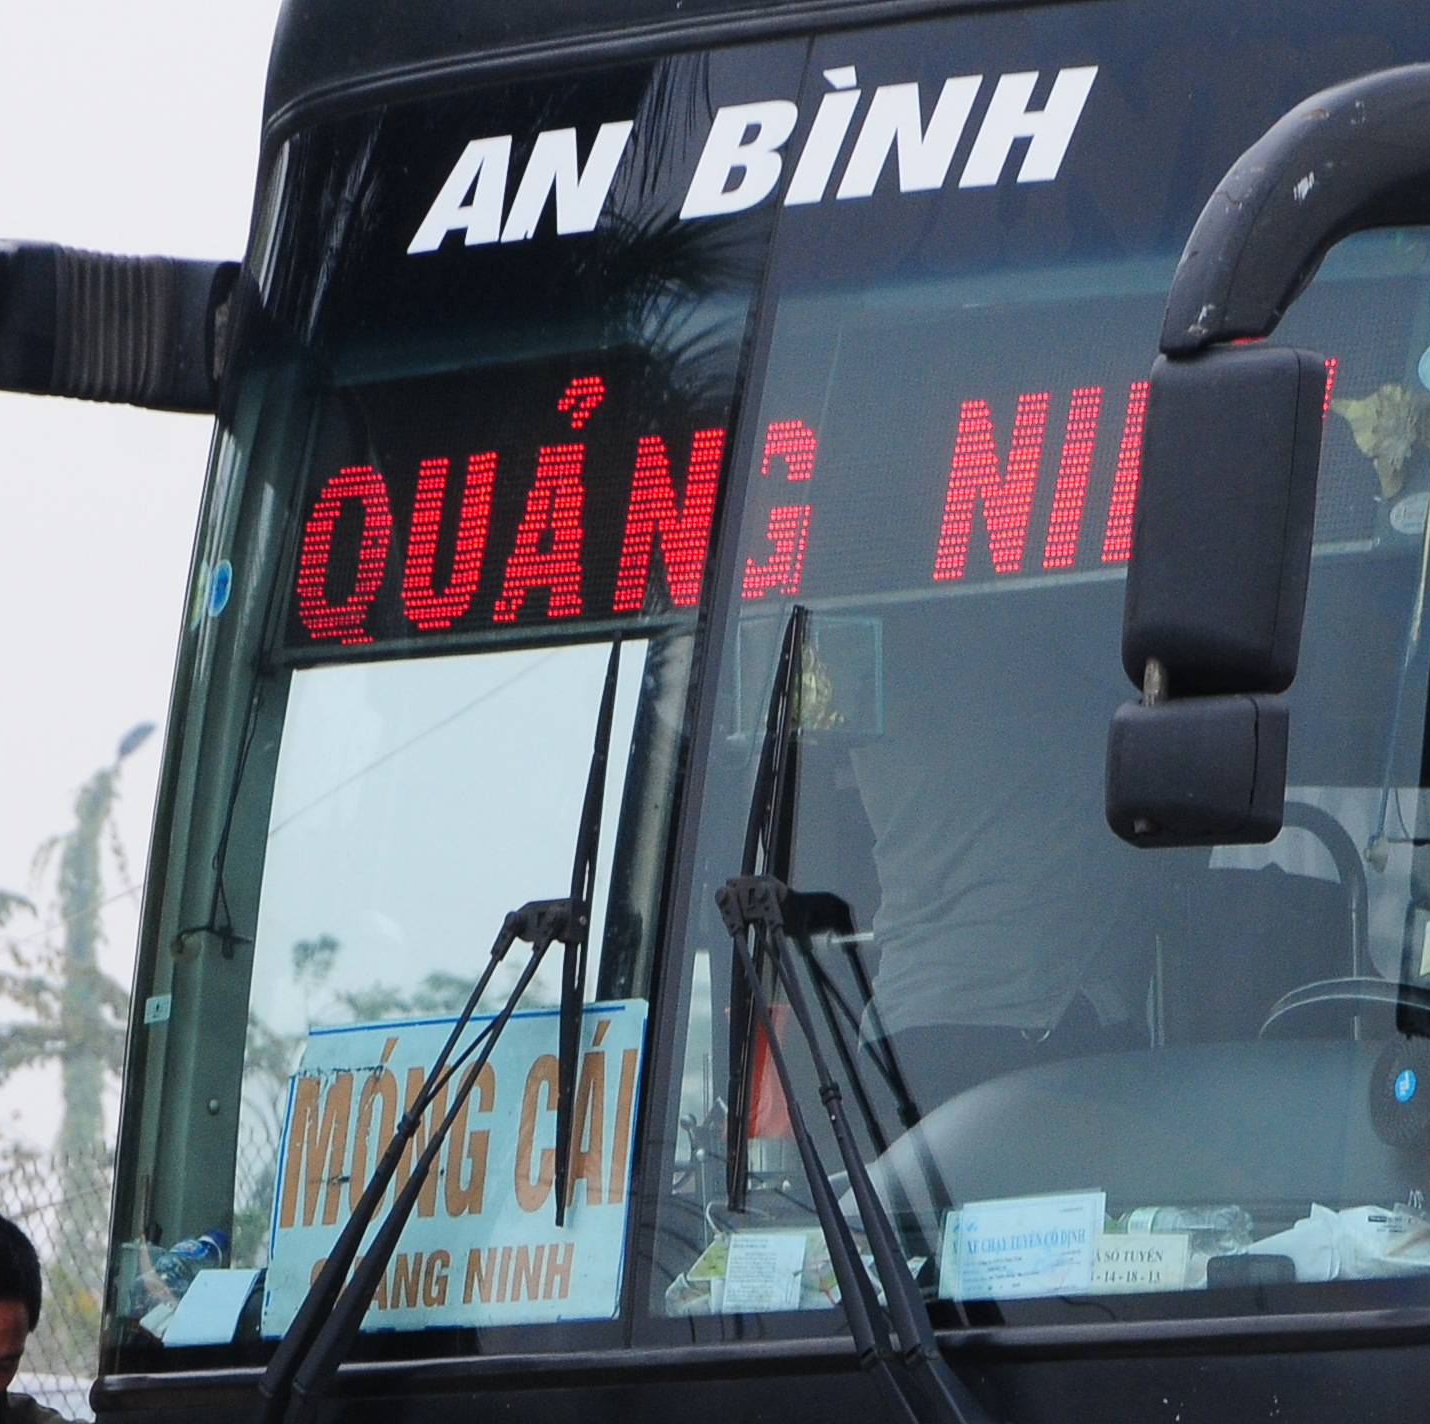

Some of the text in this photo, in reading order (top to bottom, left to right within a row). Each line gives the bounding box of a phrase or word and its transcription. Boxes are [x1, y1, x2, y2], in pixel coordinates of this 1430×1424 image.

[407, 65, 1099, 255] AN BÌNH
[296, 375, 817, 645] QUẢNG
[280, 1020, 639, 1229] MÓNG CÁI
[463, 1243, 574, 1305] NINH
